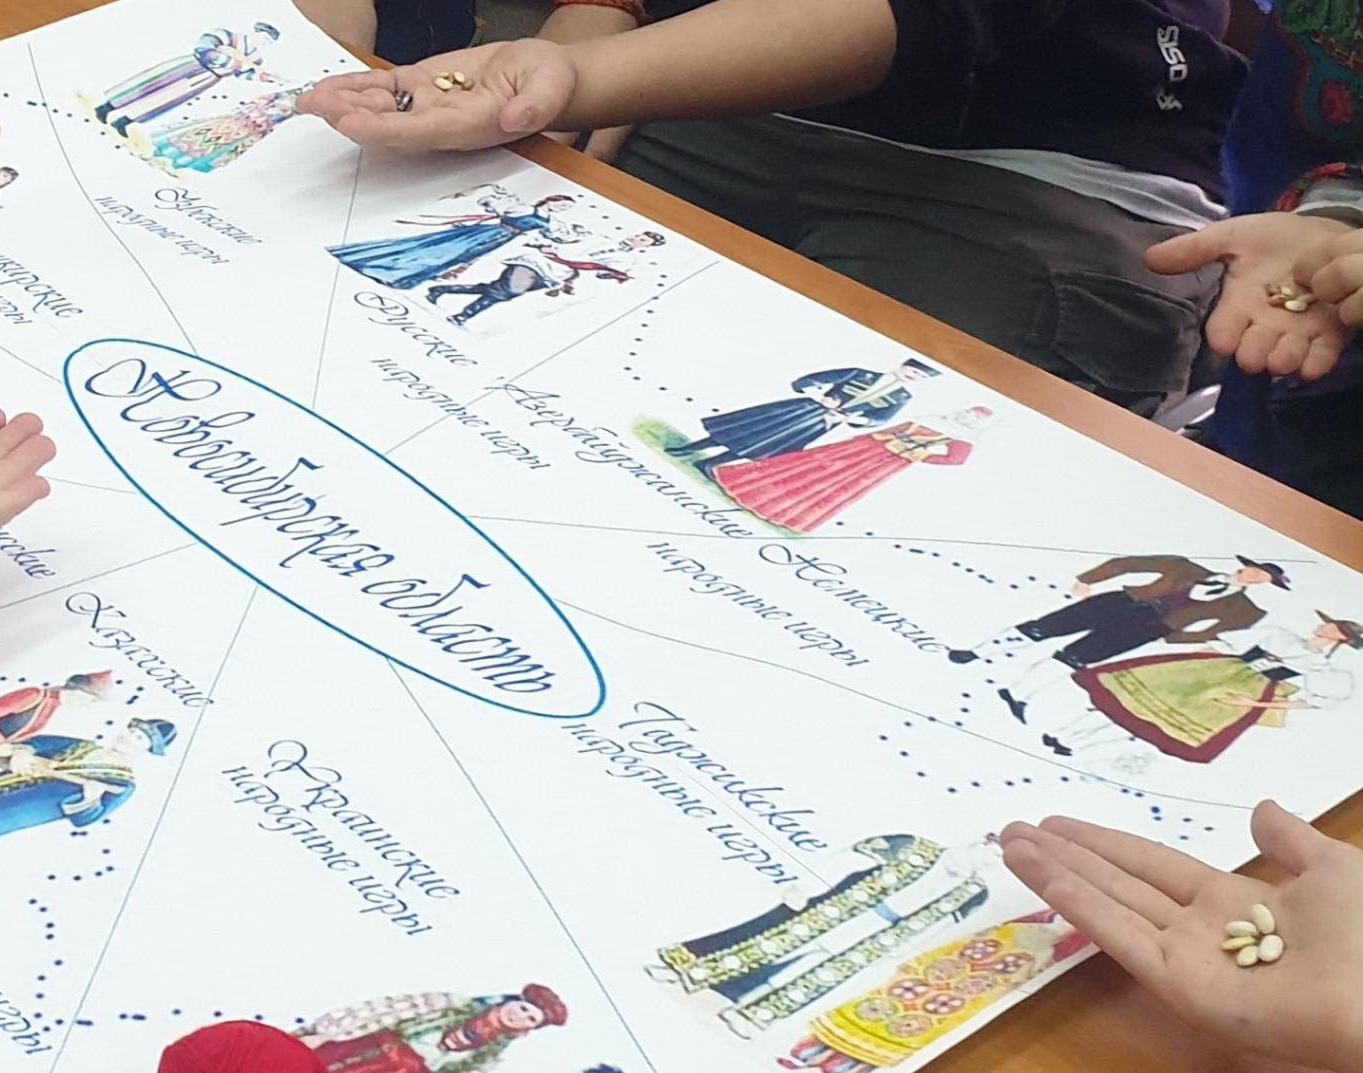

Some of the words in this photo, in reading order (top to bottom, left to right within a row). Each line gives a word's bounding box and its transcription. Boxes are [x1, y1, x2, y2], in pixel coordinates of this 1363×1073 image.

[354, 291, 478, 367] Русские
[370, 358, 491, 428] народные
[480, 430, 551, 470] игры
[484, 376, 754, 539] Азербайджанские
[84, 358, 396, 578] Новосибирская
[360, 573, 556, 694] область
[758, 543, 951, 653] Немецкие
[65, 591, 215, 709] Казахские
[646, 541, 793, 621] народные
[783, 621, 870, 667] игры
[221, 765, 361, 872] народные
[348, 875, 433, 937] игры
[263, 739, 461, 899] Украинские
[561, 723, 717, 818] народные
[706, 823, 799, 885] игры
[617, 701, 828, 853] Таджикские
